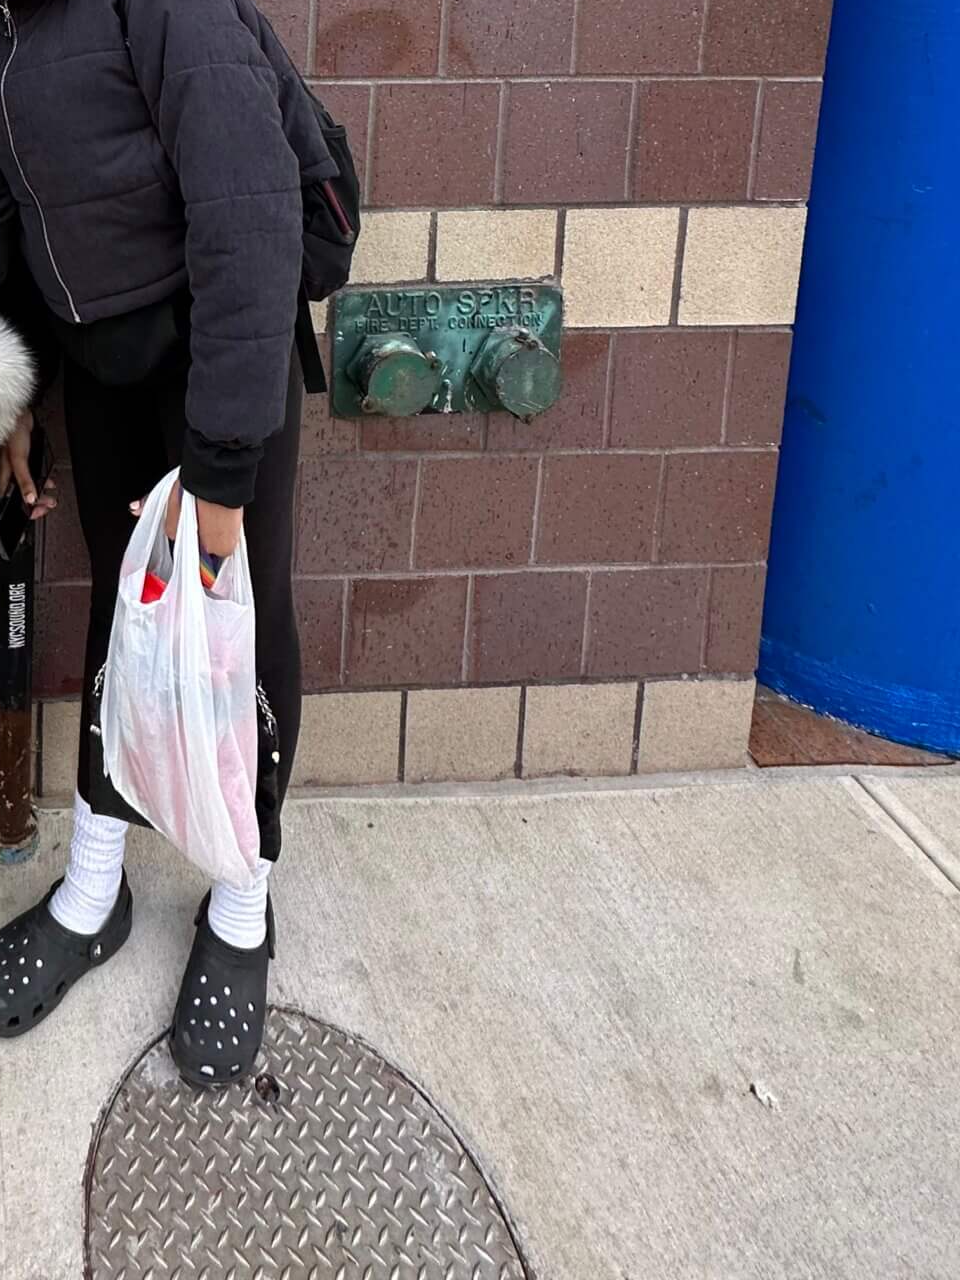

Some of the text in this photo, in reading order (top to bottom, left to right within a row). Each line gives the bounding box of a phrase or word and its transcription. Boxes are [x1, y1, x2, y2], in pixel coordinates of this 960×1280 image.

[367, 287, 537, 318] AUTO SPKR
[355, 318, 390, 334] FIRE
[448, 311, 546, 330] CONNECTION
